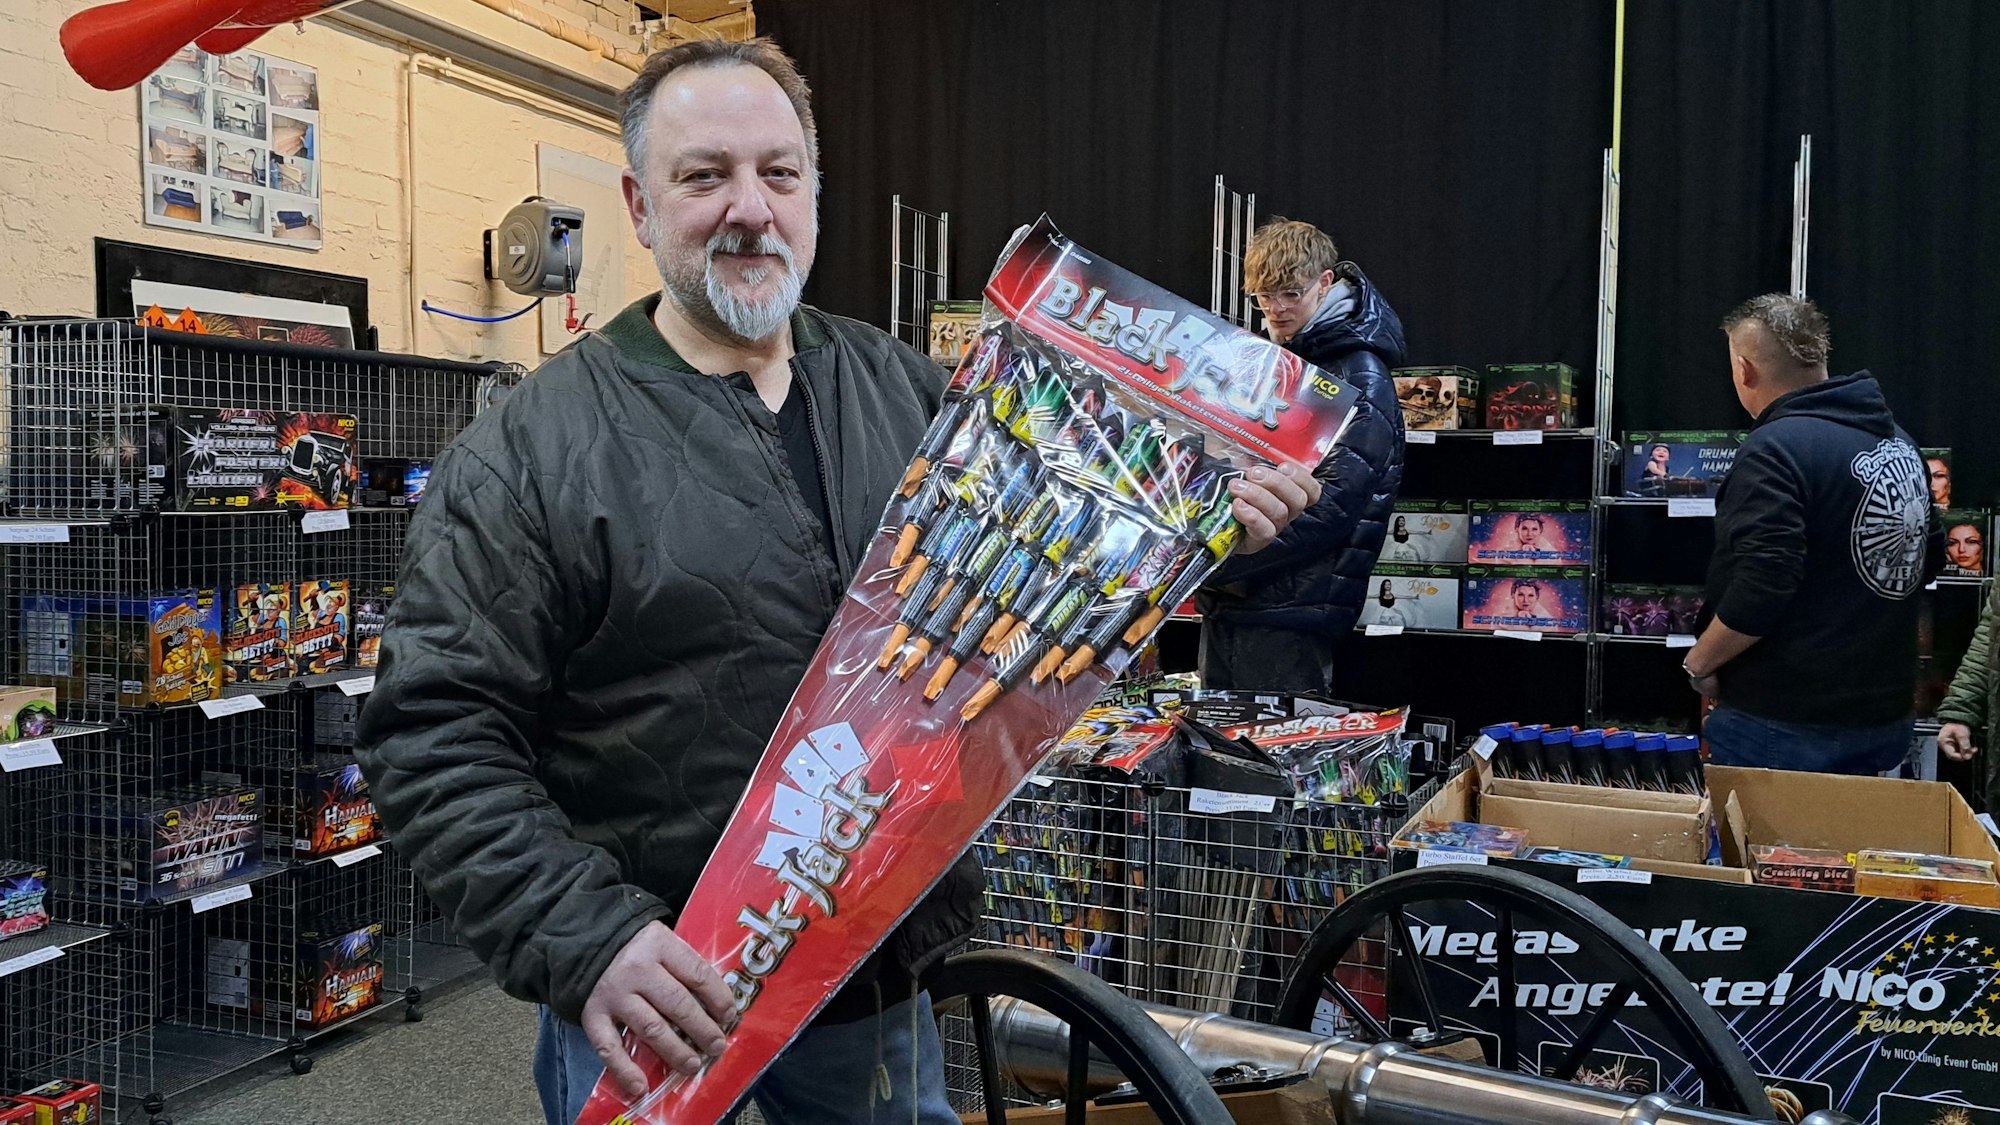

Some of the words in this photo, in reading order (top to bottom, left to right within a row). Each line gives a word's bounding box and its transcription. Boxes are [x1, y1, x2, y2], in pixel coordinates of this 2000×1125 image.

[180, 317, 197, 332] 1.4
[1036, 275, 1180, 373] Black
[337, 419, 355, 428] NICO
[1698, 448, 1738, 459] DRUMM
[1701, 462, 1733, 473] HAMM
[242, 638, 276, 661] BETTY
[303, 633, 334, 655] BETTY
[214, 813, 257, 822] megafetti
[166, 831, 242, 866] WAHN
[774, 776, 890, 919] Jack
[1421, 850, 1442, 859] Turbo
[1444, 853, 1468, 862] Staffel
[1824, 869, 1849, 879] bird
[1397, 919, 1748, 964] Megasrke
[325, 965, 377, 998] HAWAII
[1819, 966, 1946, 1012] NICO
[1468, 972, 1794, 1016] Angete!
[1880, 1046, 1891, 1060] by
[1944, 1054, 1969, 1069] Event
[1971, 1059, 1999, 1073] GmbH
